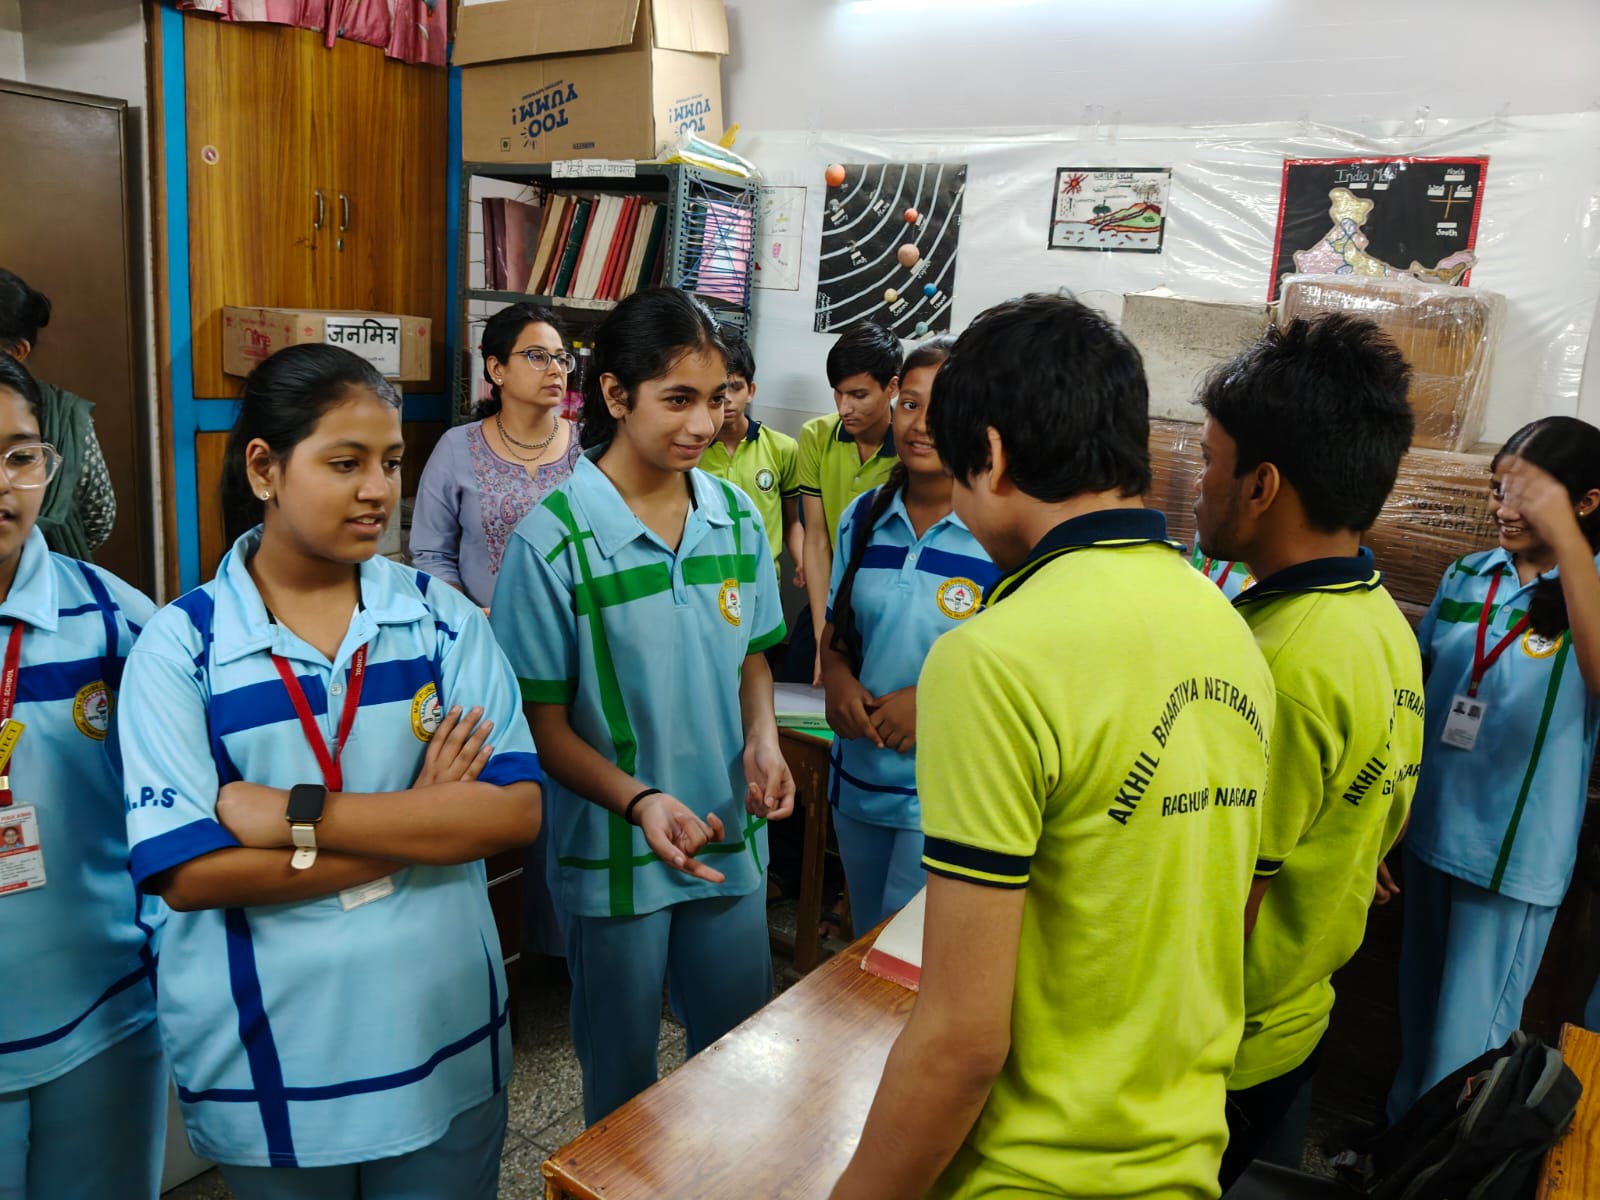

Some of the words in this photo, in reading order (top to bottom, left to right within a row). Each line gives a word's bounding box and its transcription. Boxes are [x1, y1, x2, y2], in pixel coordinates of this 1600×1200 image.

[512, 83, 578, 125] YUMM!
[669, 98, 711, 123] YUMM!
[528, 109, 568, 137] TOO
[1334, 167, 1370, 183] India
[1436, 229, 1458, 237] South
[327, 318, 399, 344] जनमित्र
[4, 669, 14, 696] SCHOOL
[1107, 751, 1160, 826] AKHIL
[1152, 677, 1199, 749] BHARTIYA
[1342, 756, 1388, 807] AKHIL
